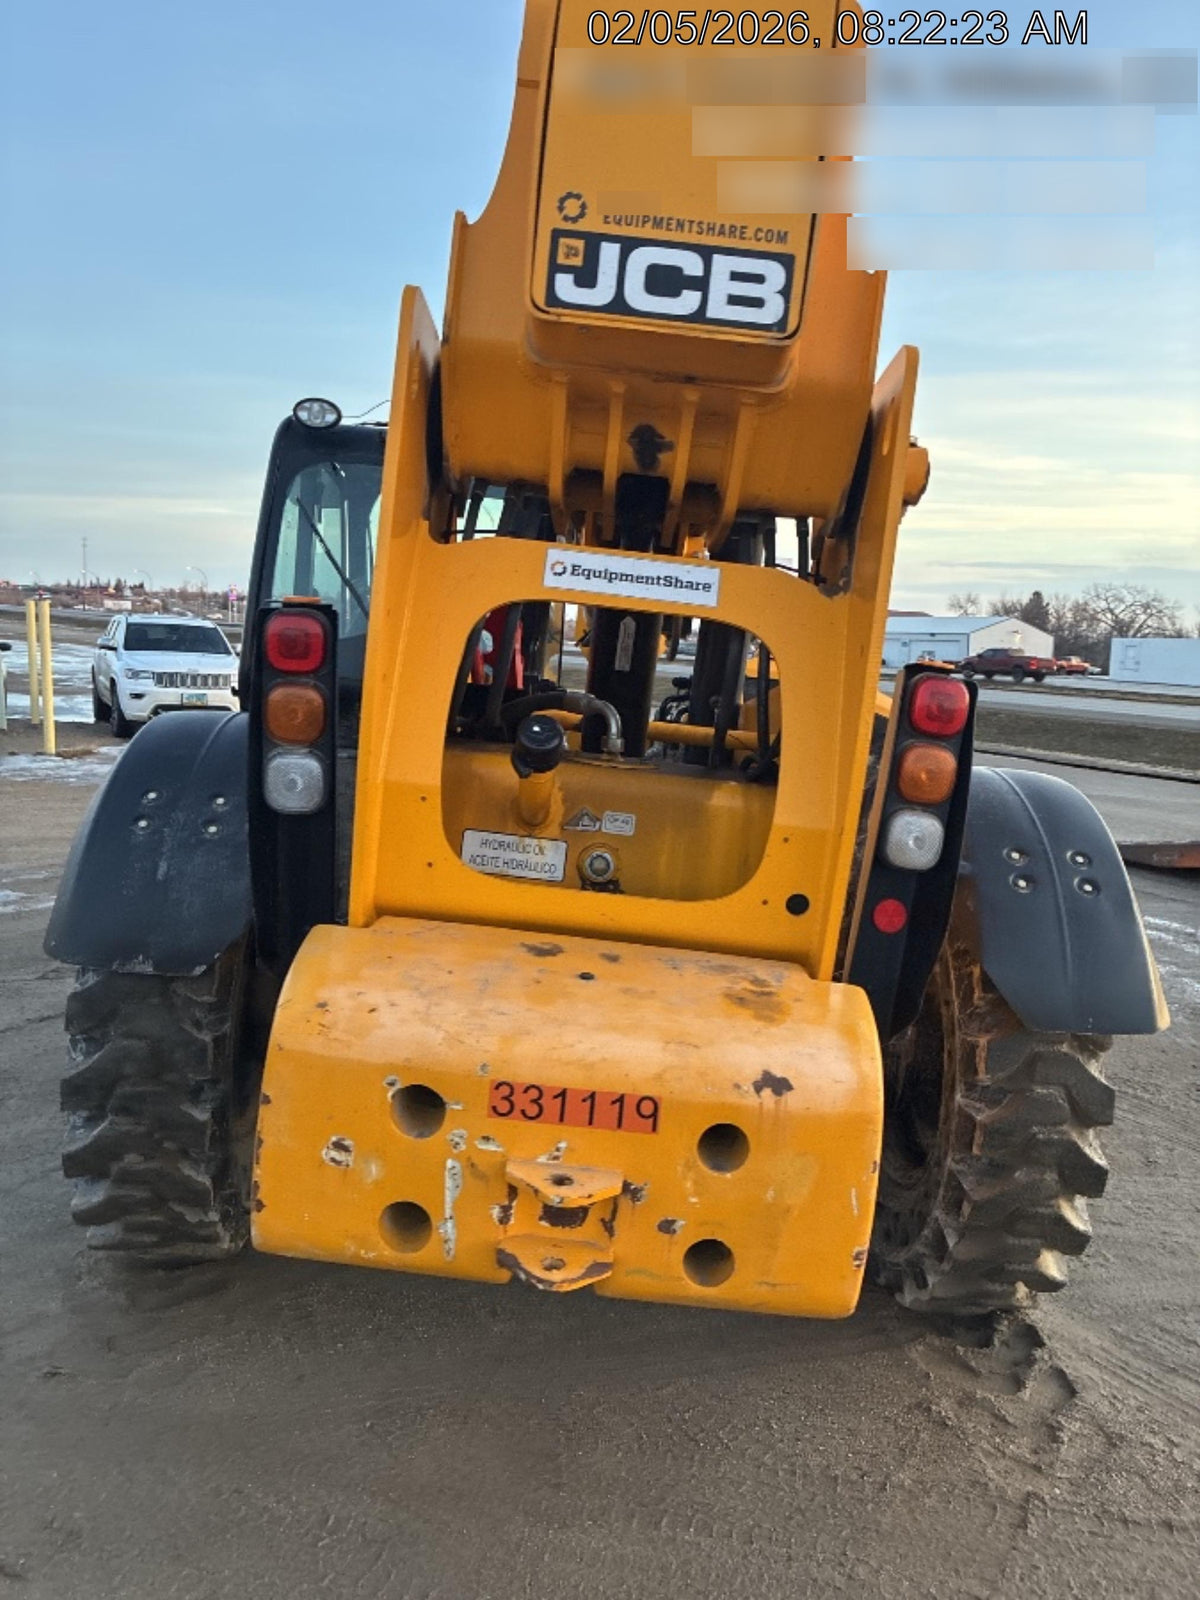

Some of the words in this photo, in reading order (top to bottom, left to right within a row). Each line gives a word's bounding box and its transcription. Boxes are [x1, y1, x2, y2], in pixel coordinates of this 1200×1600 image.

[554, 241, 787, 325] JCB
[570, 564, 712, 593] EquipmentShare
[491, 1080, 659, 1133] 331119
